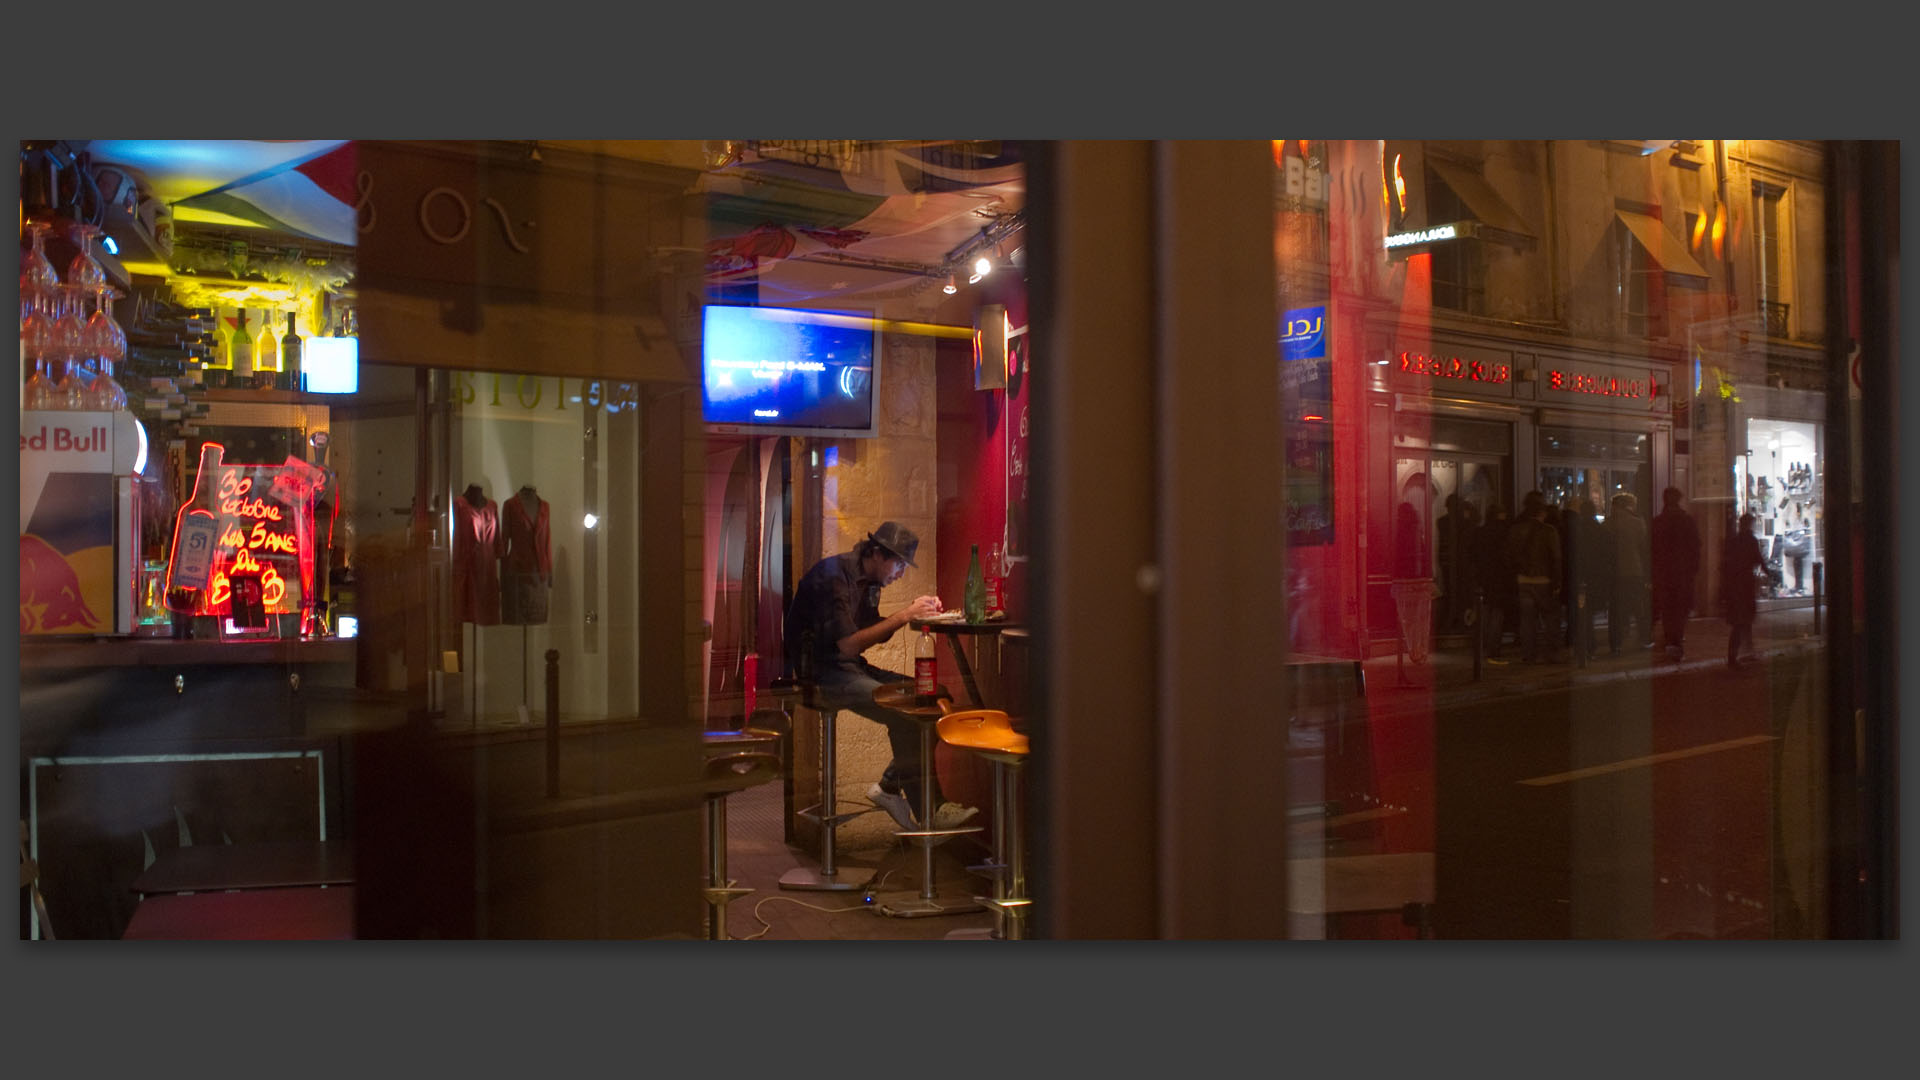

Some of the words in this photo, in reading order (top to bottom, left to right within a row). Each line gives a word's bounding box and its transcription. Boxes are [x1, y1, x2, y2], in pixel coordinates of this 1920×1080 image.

[53, 427, 106, 452] Bull
[218, 468, 253, 500] 30
[189, 532, 207, 549] 51
